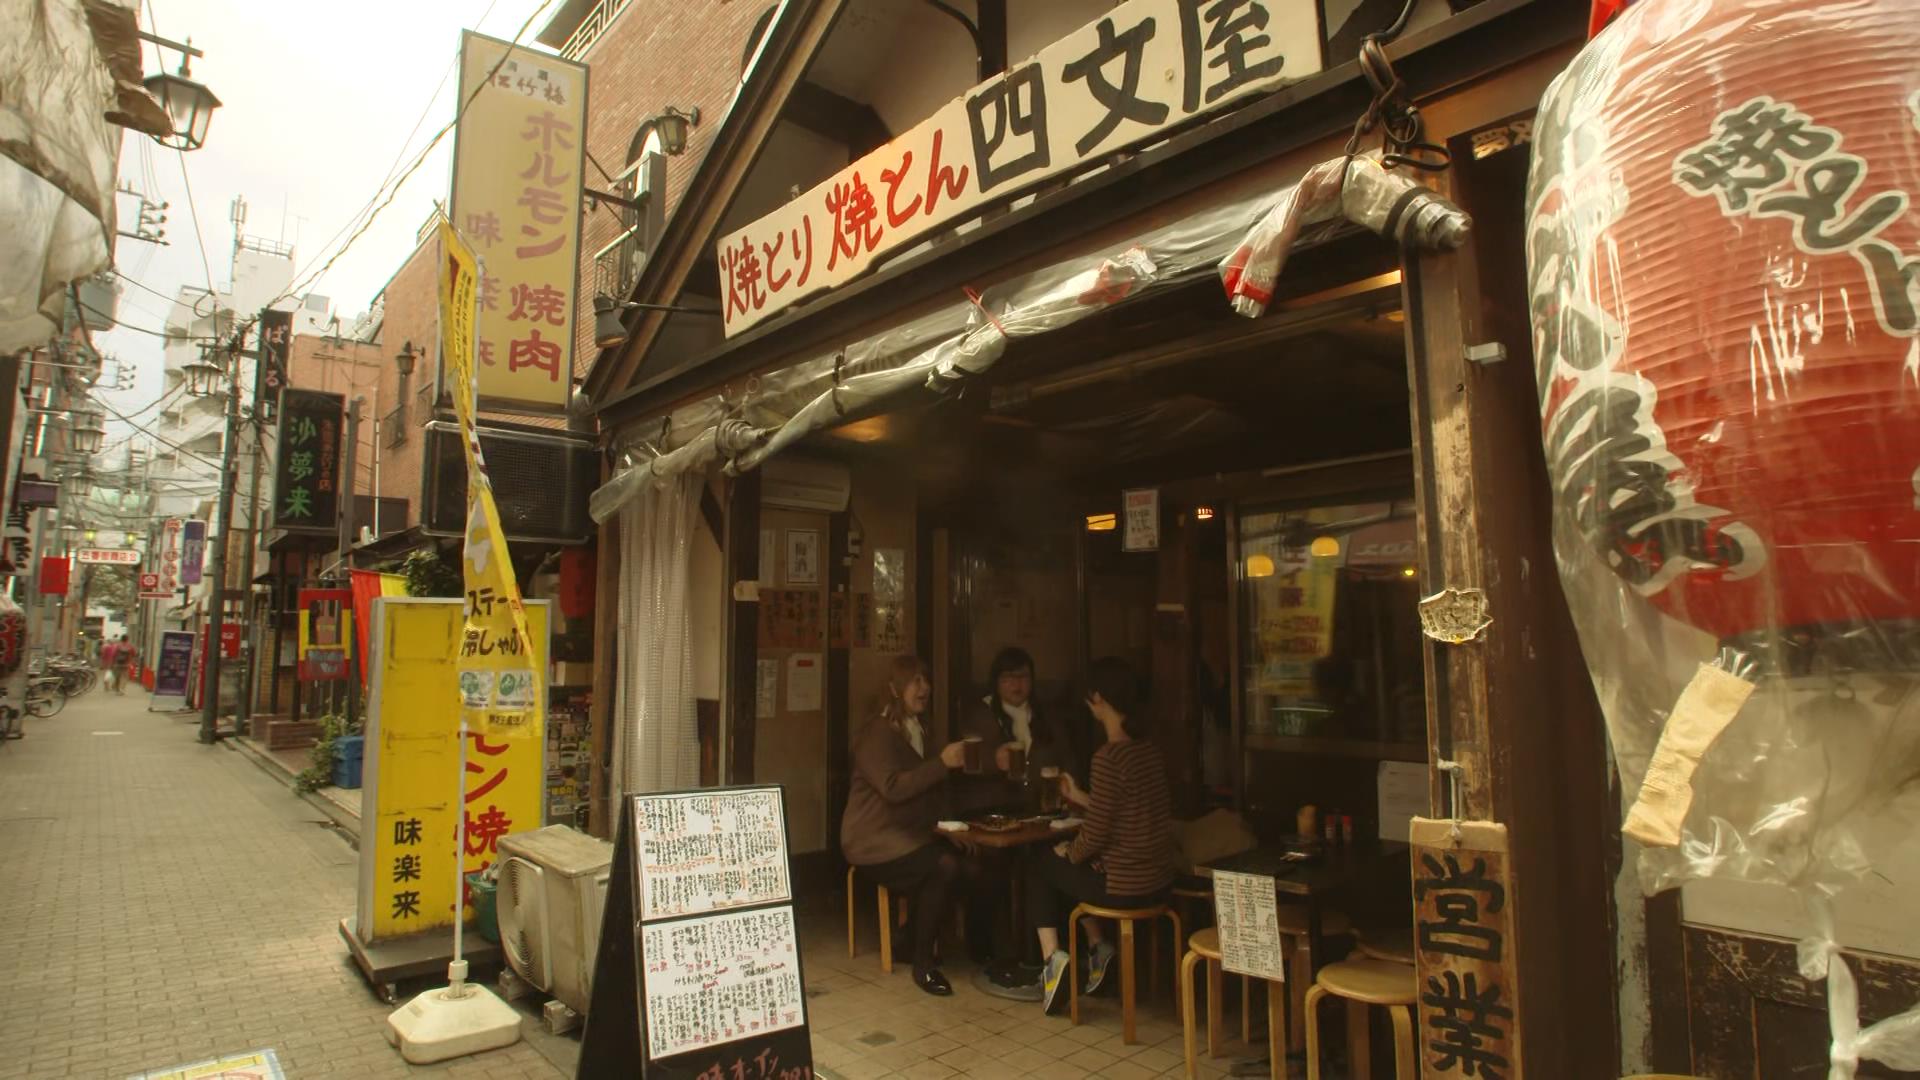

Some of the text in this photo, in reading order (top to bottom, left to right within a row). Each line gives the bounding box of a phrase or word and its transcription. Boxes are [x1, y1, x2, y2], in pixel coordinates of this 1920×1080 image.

[720, 0, 1285, 326] 焼とり 焼とん 四文屋
[392, 817, 422, 919] 味楽来
